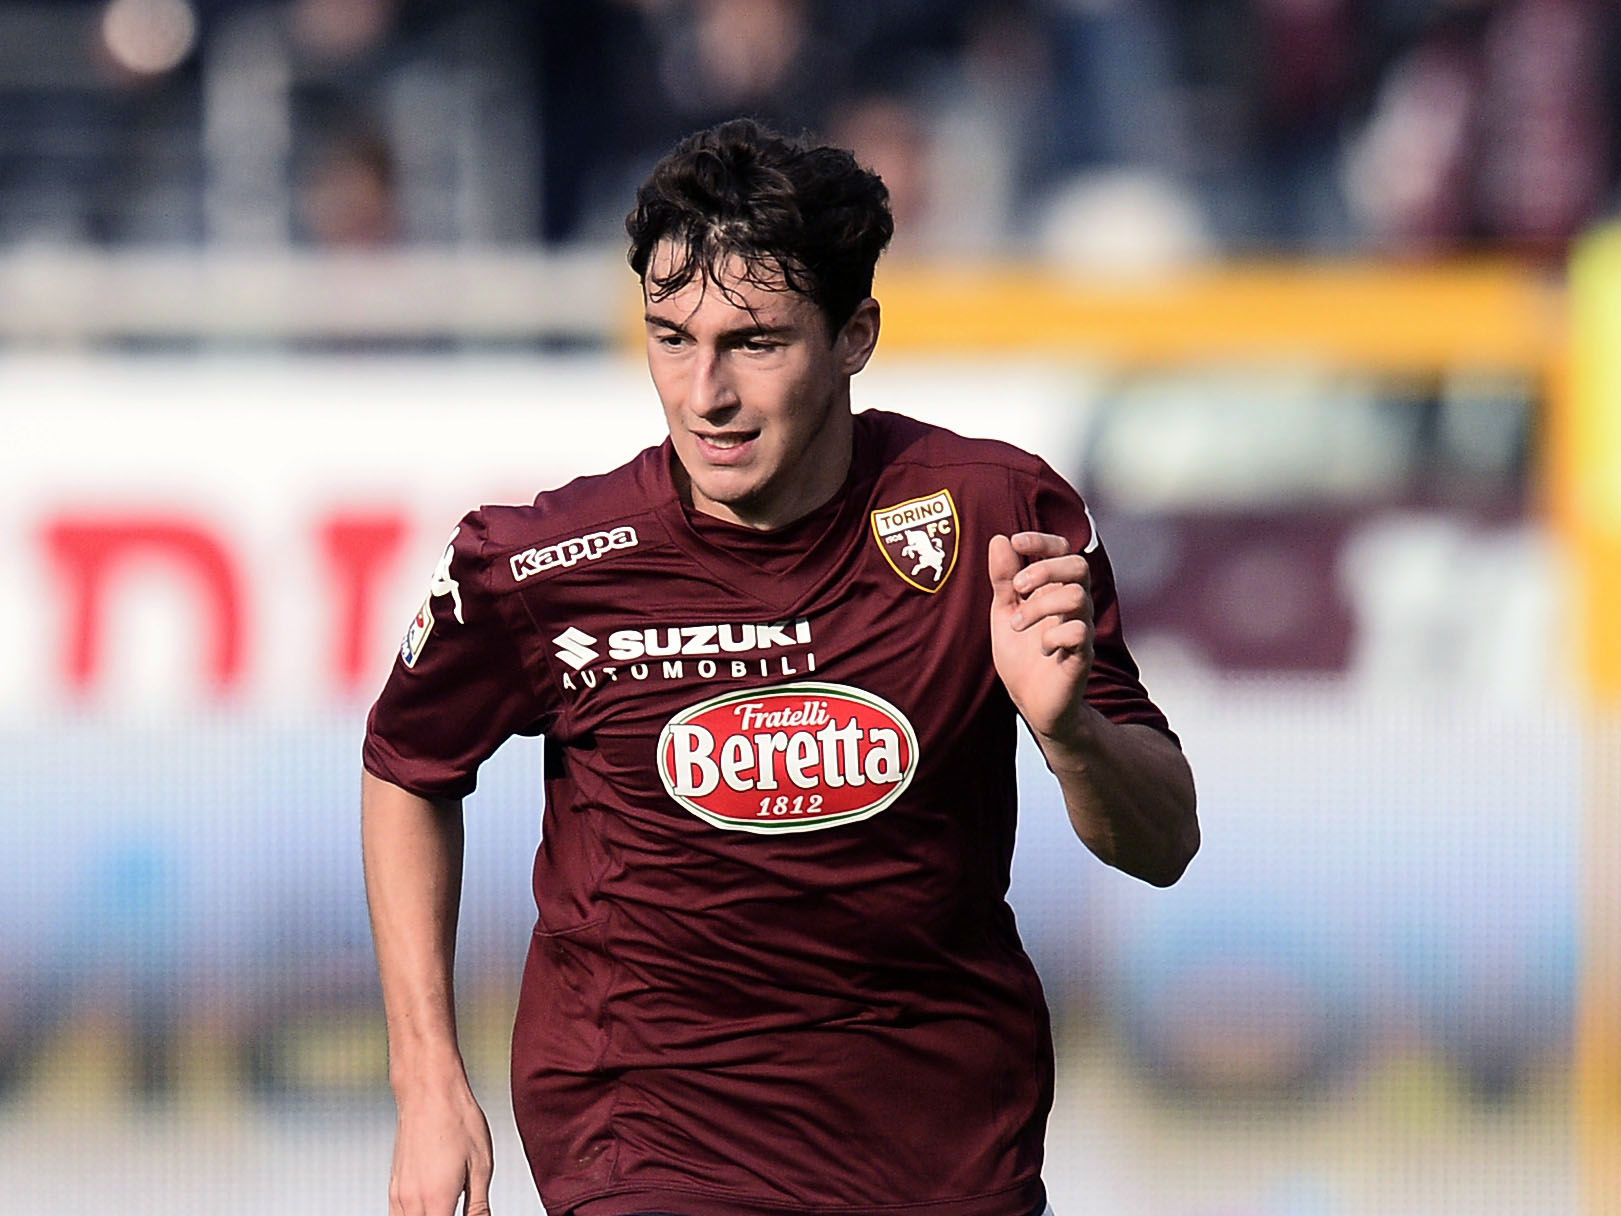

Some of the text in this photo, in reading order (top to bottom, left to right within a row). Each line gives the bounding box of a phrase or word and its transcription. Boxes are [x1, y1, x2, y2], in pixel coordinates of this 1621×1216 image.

[880, 500, 944, 530] TORINO
[926, 519, 951, 538] FC
[509, 526, 639, 582] Kappa
[608, 617, 813, 661] SUZUKI
[563, 652, 817, 691] AUTOMOBILI
[733, 700, 830, 731] Fratelli
[668, 717, 905, 798] Beretta
[756, 794, 823, 817] 1812
